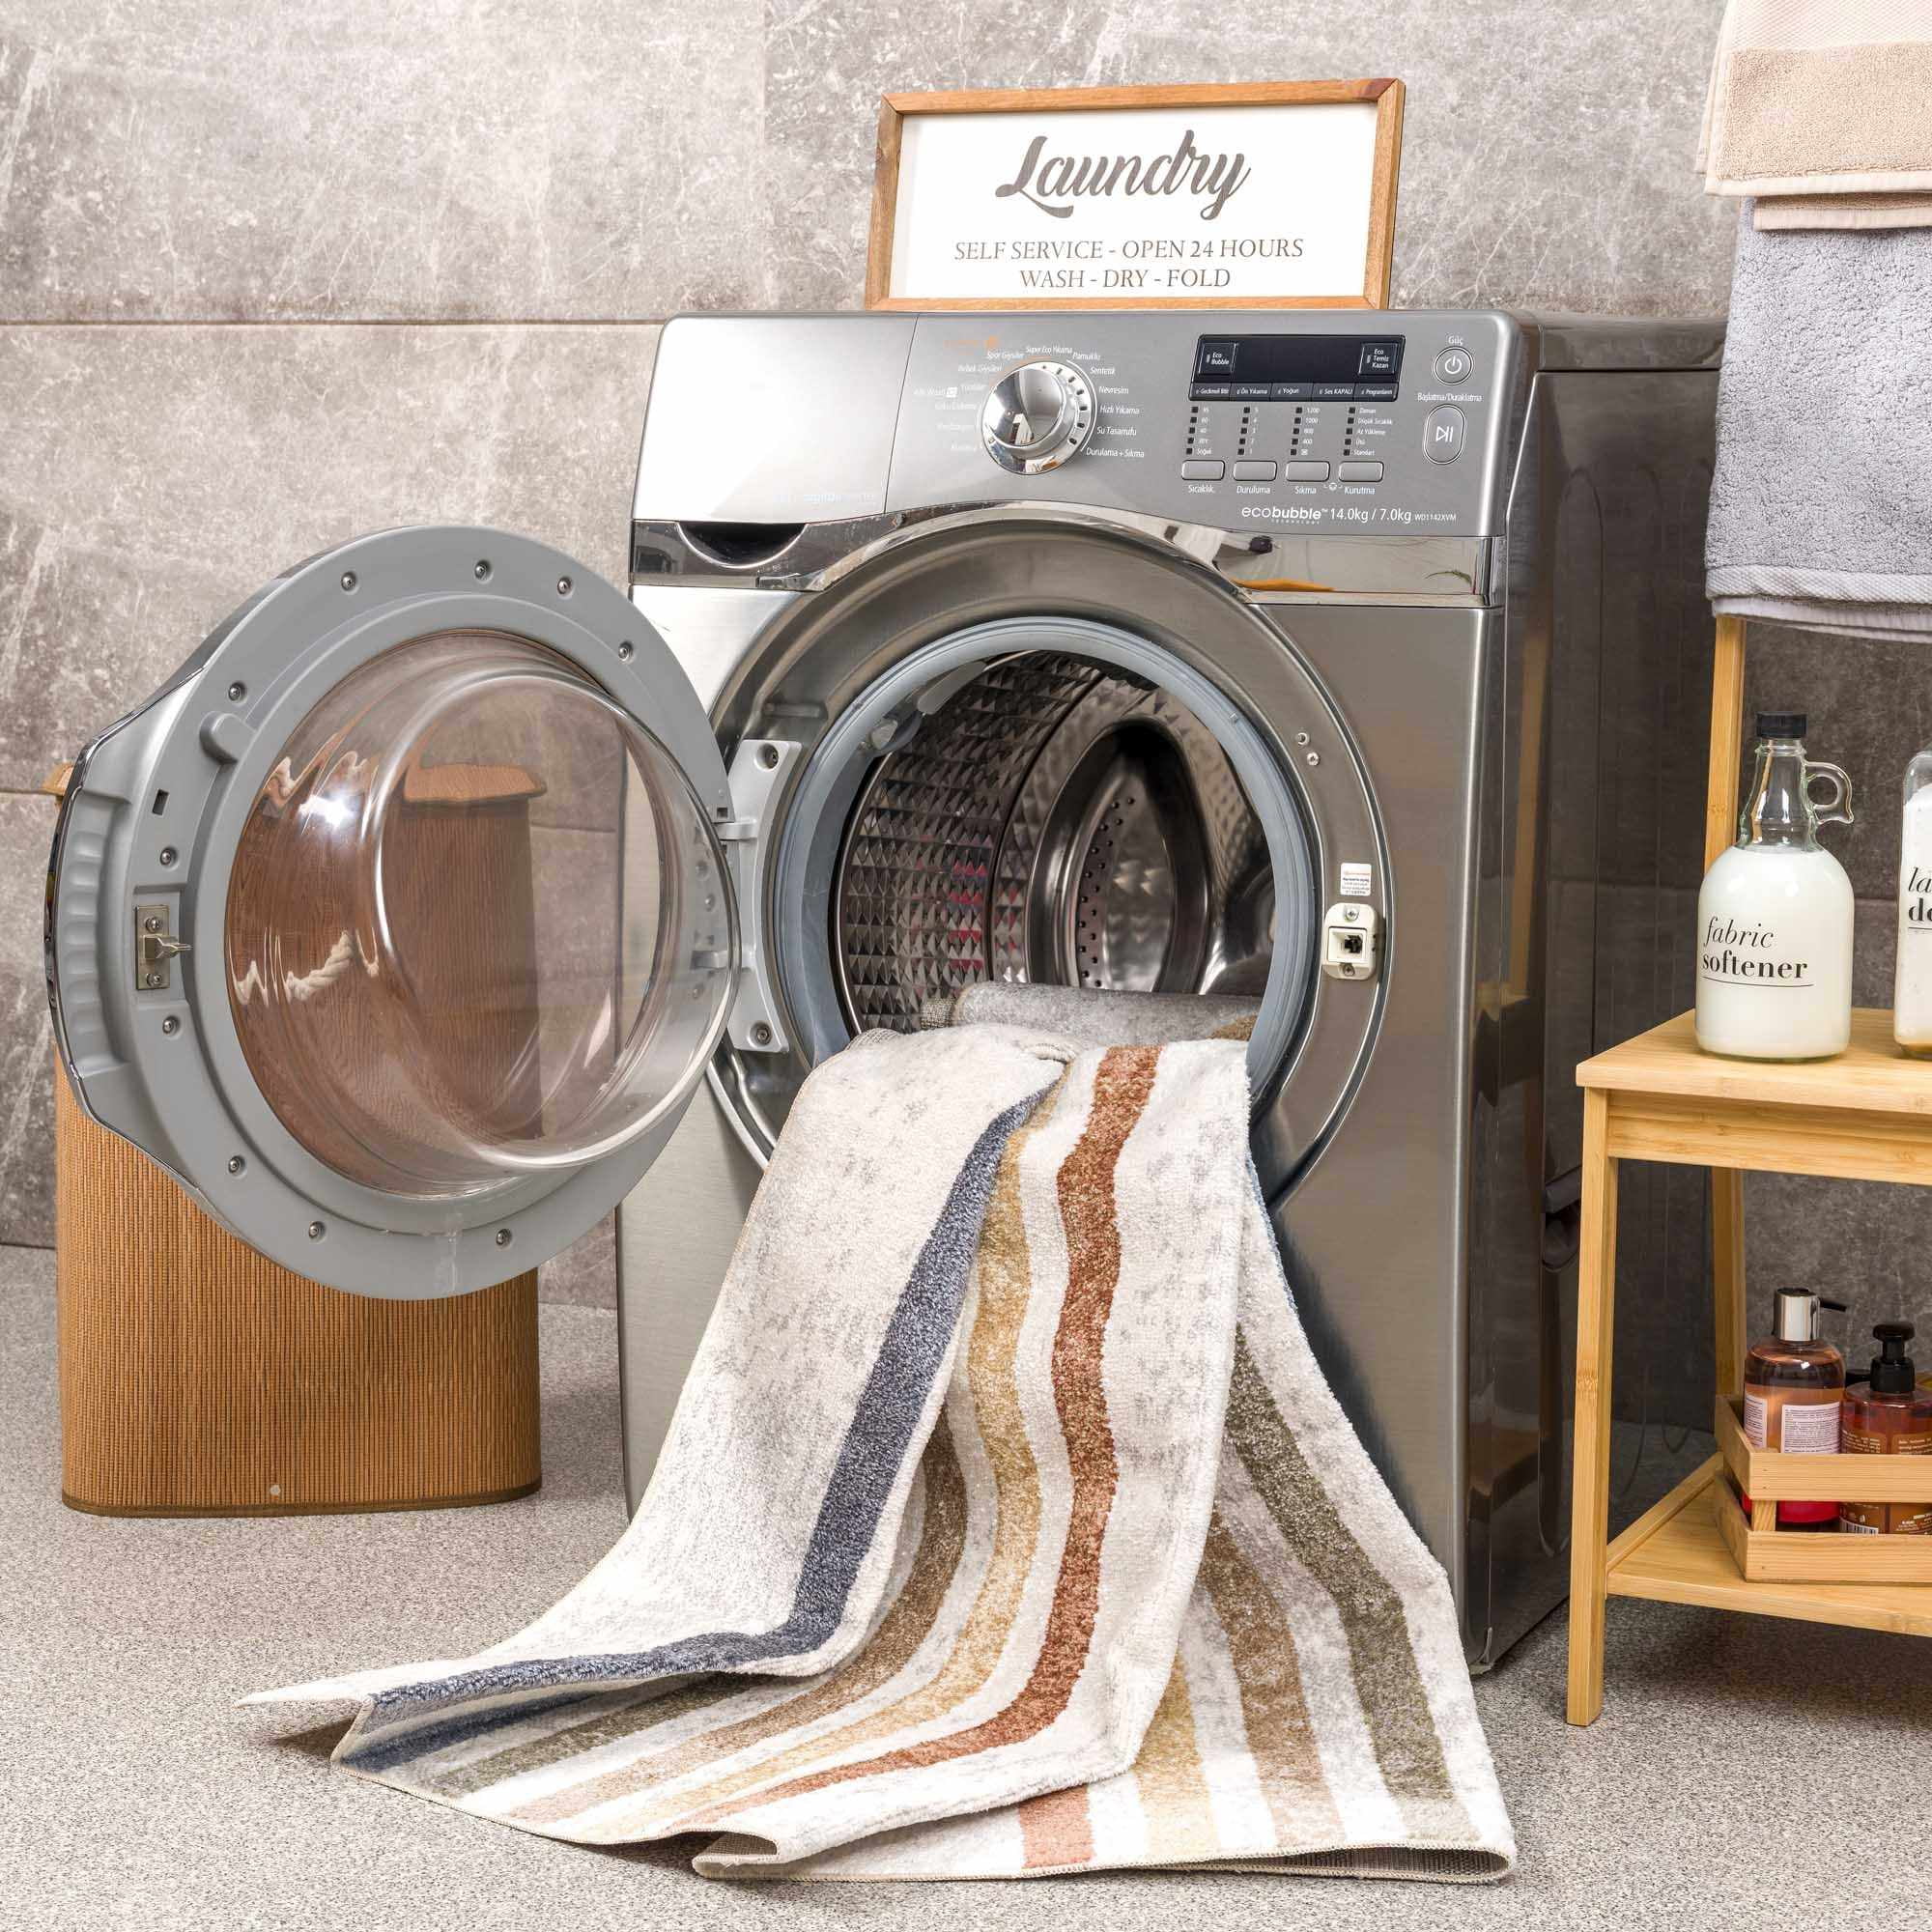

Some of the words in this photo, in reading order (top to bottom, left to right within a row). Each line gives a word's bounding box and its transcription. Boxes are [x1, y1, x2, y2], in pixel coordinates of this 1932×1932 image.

[995, 129, 1251, 220] Laundry
[954, 242, 1005, 260] SELF
[1010, 241, 1103, 260] SERVICE
[1122, 240, 1184, 259] OPEN
[1190, 240, 1214, 258] 24
[1220, 239, 1303, 258] HOURS
[1020, 270, 1084, 288] WASH
[1102, 270, 1149, 288] DRY
[1167, 269, 1231, 288] FOLD
[1330, 508, 1369, 524] 14.0kg
[1379, 508, 1411, 524] 7.0kg
[1703, 916, 1775, 949] fabric
[1702, 949, 1808, 979] softener
